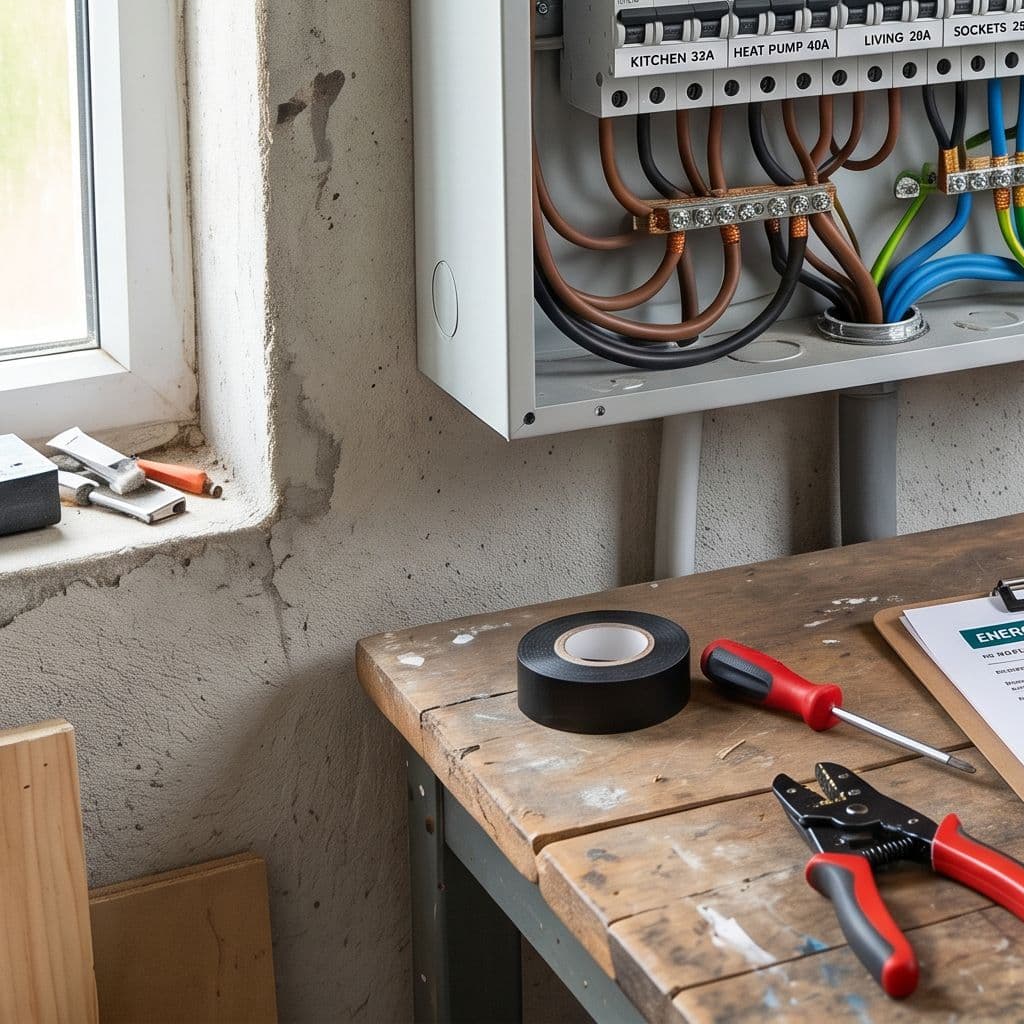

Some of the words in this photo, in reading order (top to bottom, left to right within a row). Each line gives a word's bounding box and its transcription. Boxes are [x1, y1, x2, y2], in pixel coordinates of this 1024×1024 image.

[864, 32, 904, 46] LIVING
[909, 29, 932, 42] 20A
[953, 22, 1007, 37] SOCKETS
[733, 44, 765, 59] HEAT
[768, 41, 804, 56] PUMP
[806, 38, 830, 51] 40A
[630, 52, 687, 68] KITCHEN
